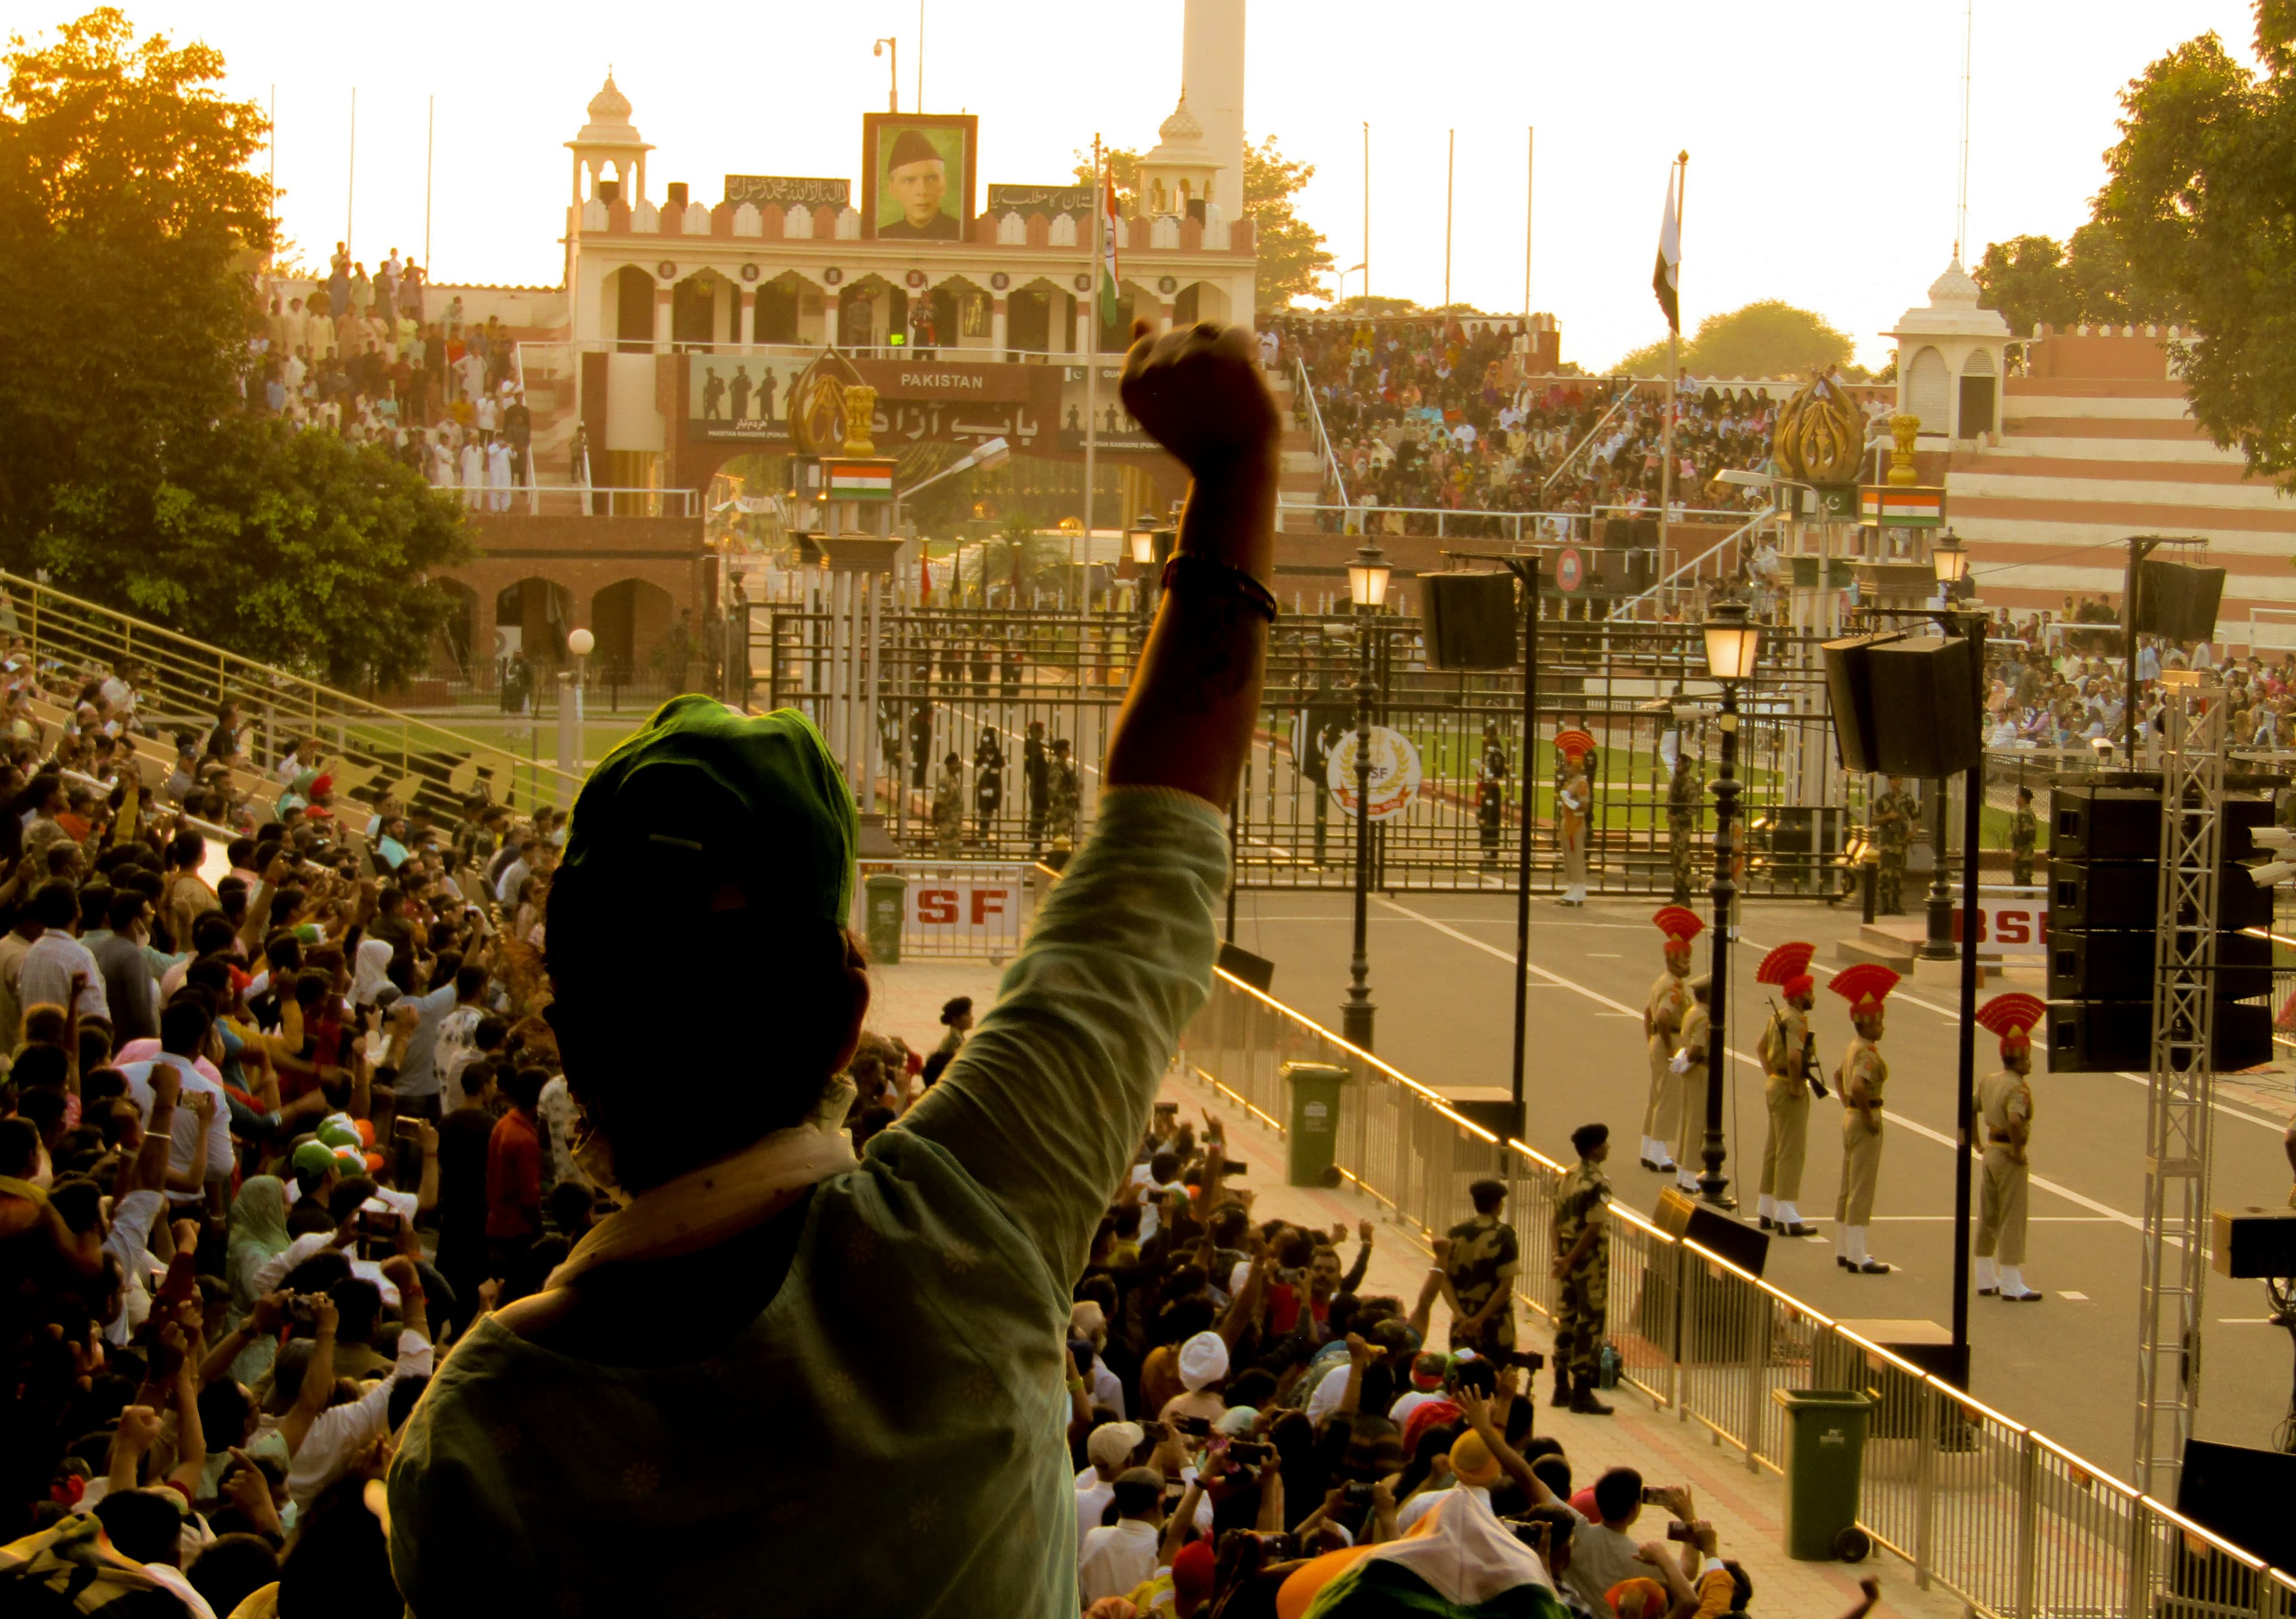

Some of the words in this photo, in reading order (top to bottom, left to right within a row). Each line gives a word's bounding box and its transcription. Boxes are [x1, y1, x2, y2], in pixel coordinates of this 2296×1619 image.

[901, 374, 983, 388] PAKISTAN
[1369, 767, 1388, 780] SF
[917, 889, 1008, 924] SF
[1952, 908, 2048, 945] BS
